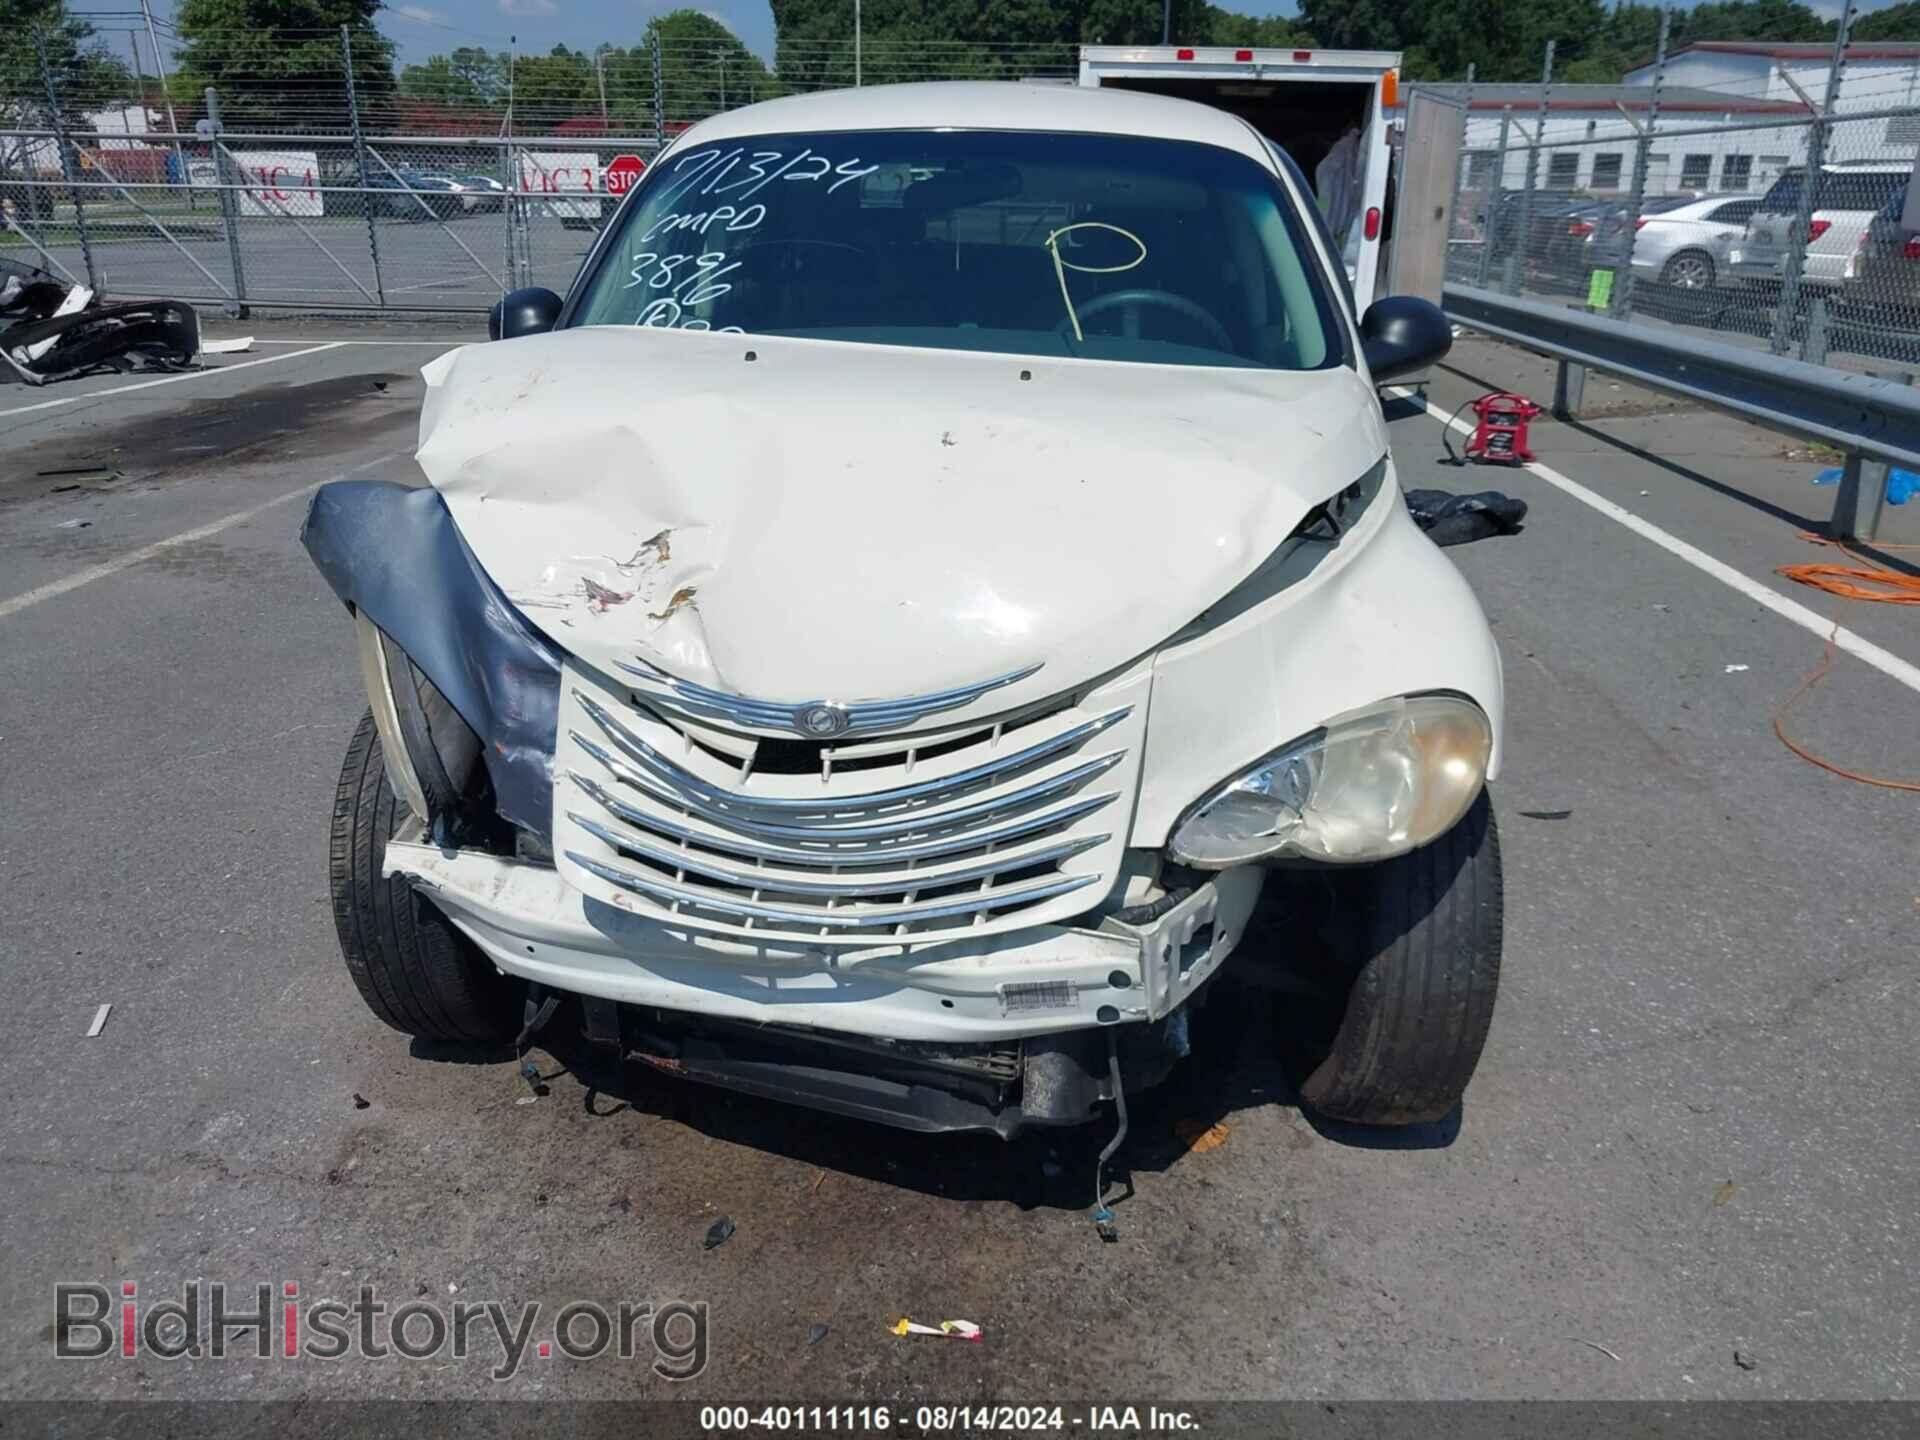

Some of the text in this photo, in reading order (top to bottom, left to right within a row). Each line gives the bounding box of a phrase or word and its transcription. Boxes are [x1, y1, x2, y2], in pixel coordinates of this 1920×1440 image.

[608, 170, 638, 190] STO
[657, 147, 880, 214] 7/13/24
[1044, 222, 1148, 342] P
